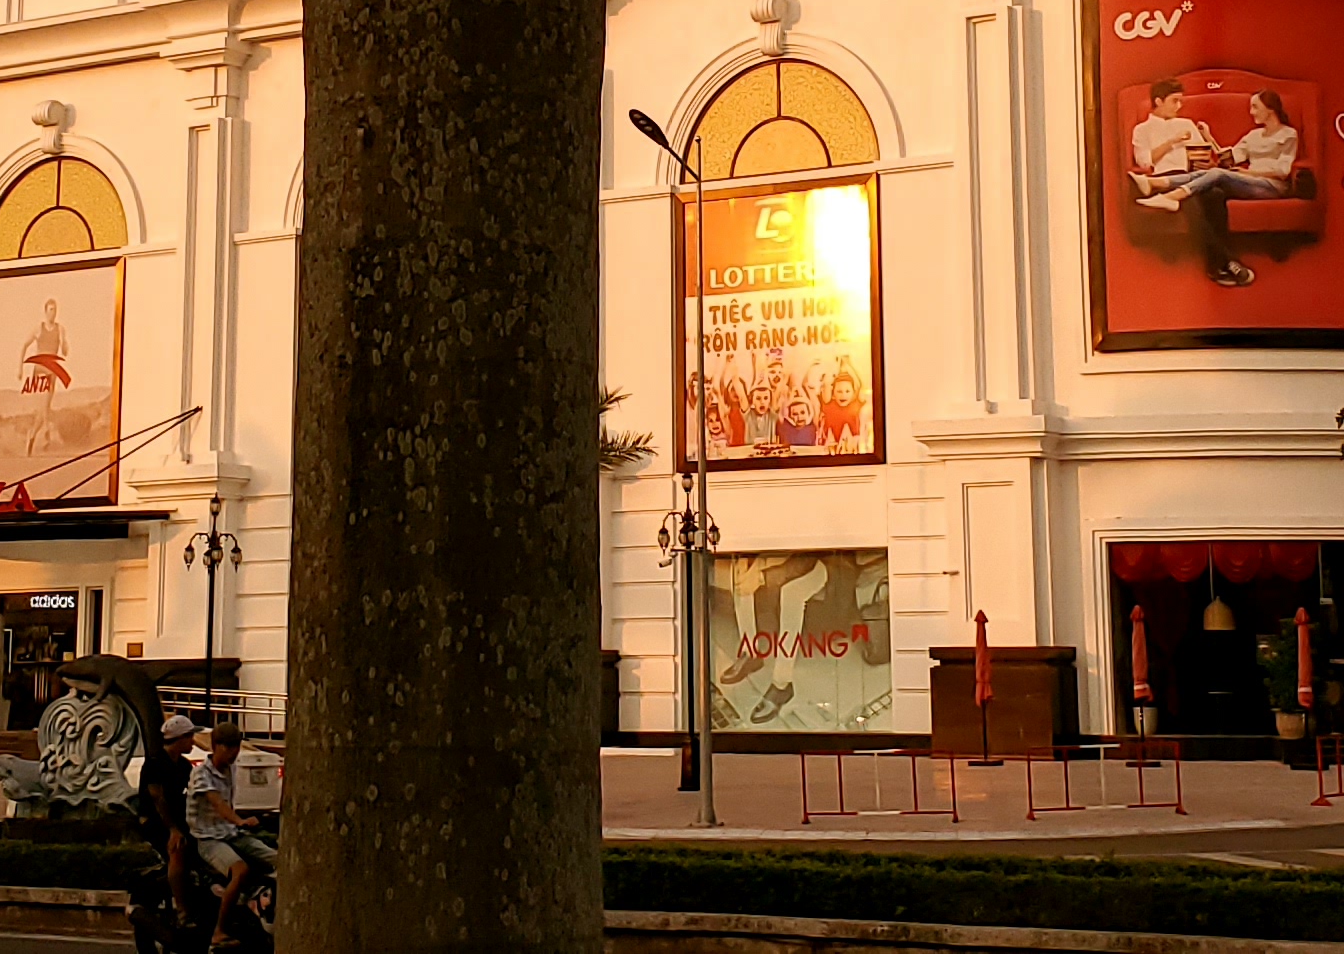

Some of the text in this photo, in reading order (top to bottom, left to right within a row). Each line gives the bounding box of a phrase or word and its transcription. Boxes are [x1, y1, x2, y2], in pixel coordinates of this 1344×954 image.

[1114, 8, 1183, 40] CGV
[709, 299, 753, 328] TIỆC
[761, 299, 794, 321] VUI
[746, 323, 798, 350] RÀNG
[21, 374, 52, 394] ANTA
[30, 594, 75, 608] adidas
[737, 630, 849, 659] AOKANG
